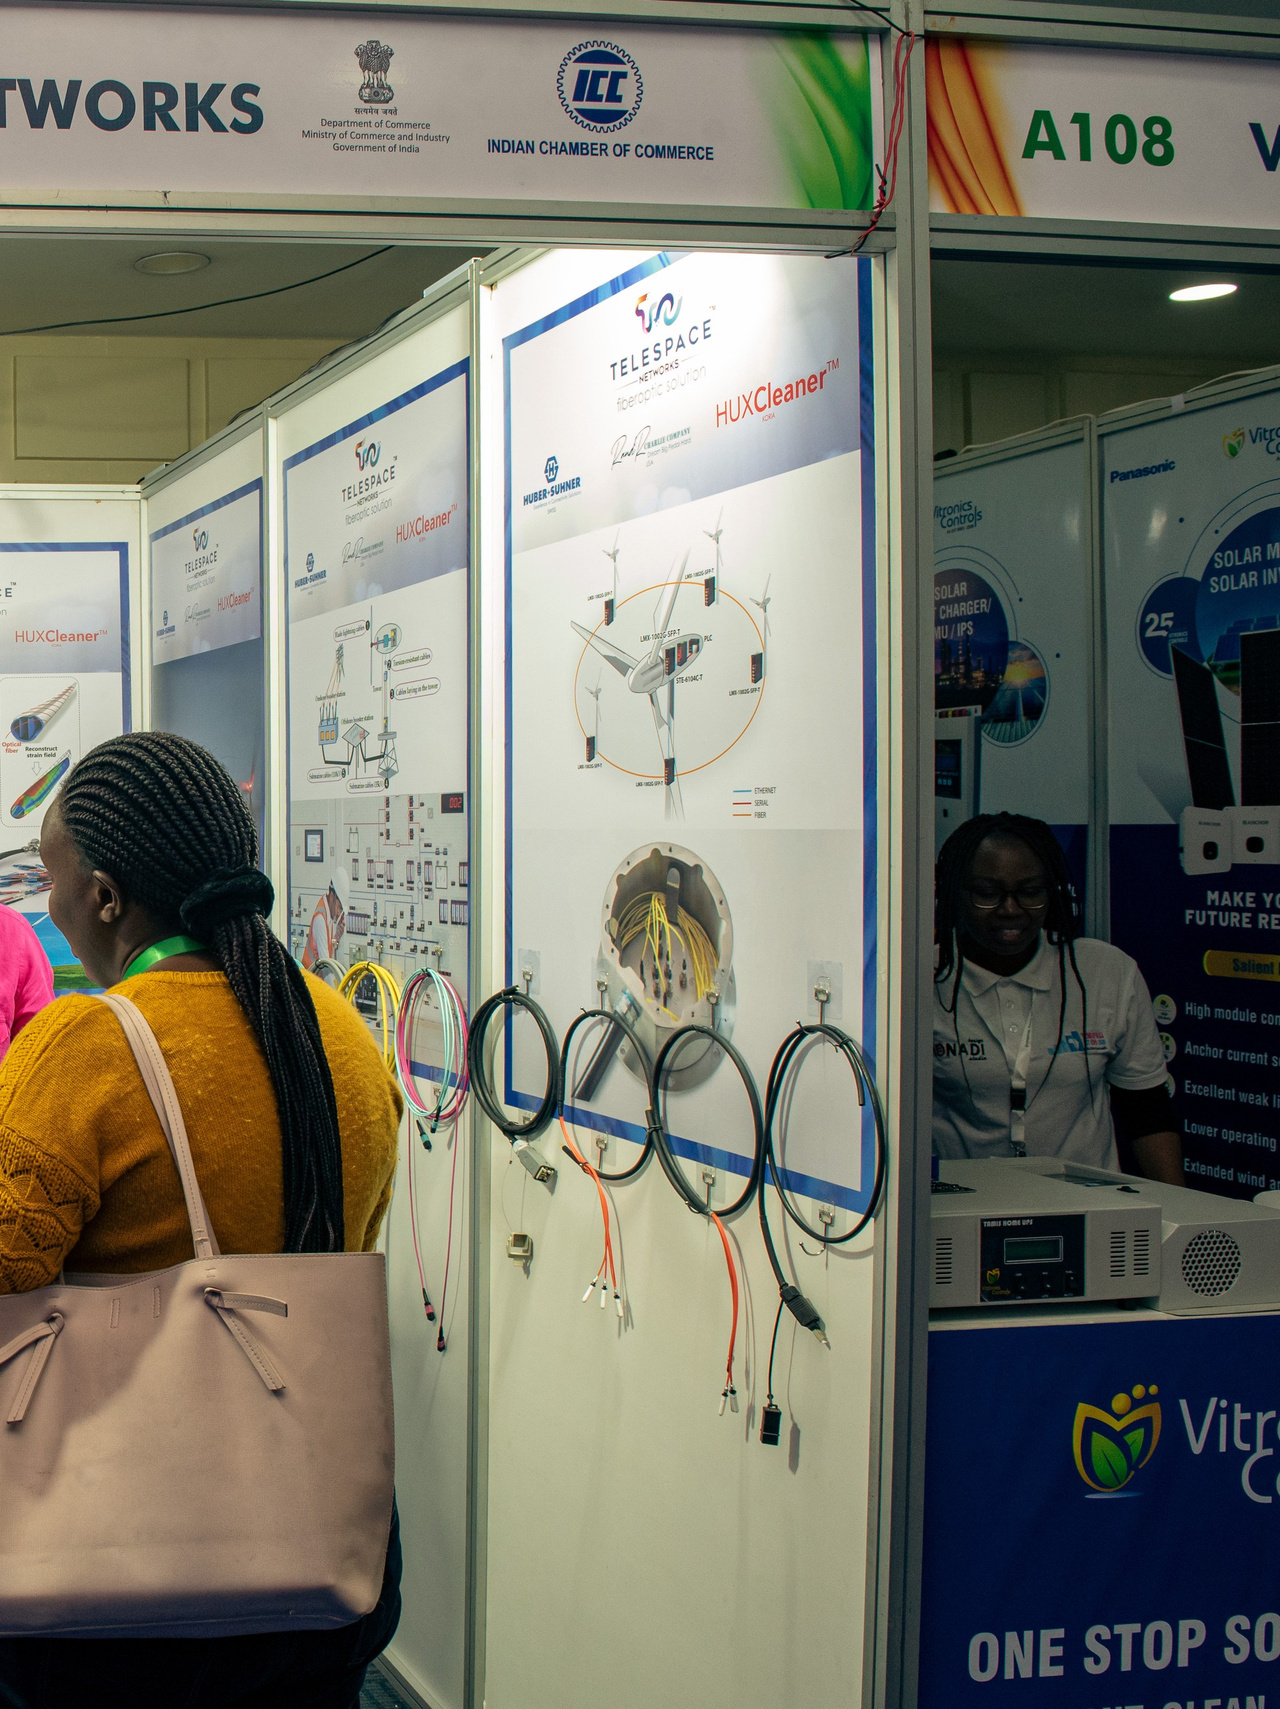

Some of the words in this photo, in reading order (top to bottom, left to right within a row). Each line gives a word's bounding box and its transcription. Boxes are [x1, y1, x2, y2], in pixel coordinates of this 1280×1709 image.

[573, 69, 627, 103] ICC
[320, 118, 373, 131] Department
[374, 119, 383, 130] of
[384, 119, 430, 130] Commerce
[302, 130, 337, 144] Ministry
[338, 131, 348, 142] of
[349, 131, 395, 142] Commerce
[397, 131, 413, 142] and
[416, 131, 450, 144] Industry
[333, 142, 387, 153] Government
[388, 143, 398, 154] of
[399, 143, 420, 154] India
[1022, 110, 1175, 167] A108
[487, 139, 535, 156] INDIAN
[539, 141, 608, 157] CHAMBER
[613, 143, 631, 157] OF
[635, 144, 714, 161] COMMERCE
[610, 319, 713, 381] TELESPACE
[639, 359, 680, 384] NETWORKS
[616, 382, 664, 413] fiberoptic
[666, 365, 707, 391] solution
[1110, 458, 1176, 484] Panasonic
[342, 465, 396, 502] TELESPACE
[371, 498, 393, 515] solution
[940, 506, 983, 529] Controls
[184, 551, 218, 574] TELESPACE
[1214, 546, 1262, 569] SOLAR
[934, 582, 968, 601] SOLAR
[1210, 571, 1258, 593] SOLAR
[640, 628, 681, 643] LMX-1002G-SFP-T
[704, 634, 713, 643] PLC
[956, 622, 974, 637] IPS
[754, 786, 777, 795] ETHERNET
[1206, 890, 1256, 908] MAKE
[1186, 910, 1253, 928] FUTURE
[1232, 958, 1274, 975] Salient
[1185, 1002, 1212, 1019] High
[1214, 1006, 1257, 1024] module
[1184, 1041, 1224, 1060] Anchor
[1227, 1049, 1269, 1066] current
[1184, 1080, 1236, 1101] Excellent
[1238, 1088, 1269, 1106] weak
[1184, 1119, 1219, 1138] Lower
[1221, 1126, 1278, 1151] operating
[1184, 1158, 1234, 1182] Extended
[1237, 1167, 1266, 1189] wind
[968, 1627, 1065, 1682] ONE
[1084, 1618, 1207, 1676] STOP
